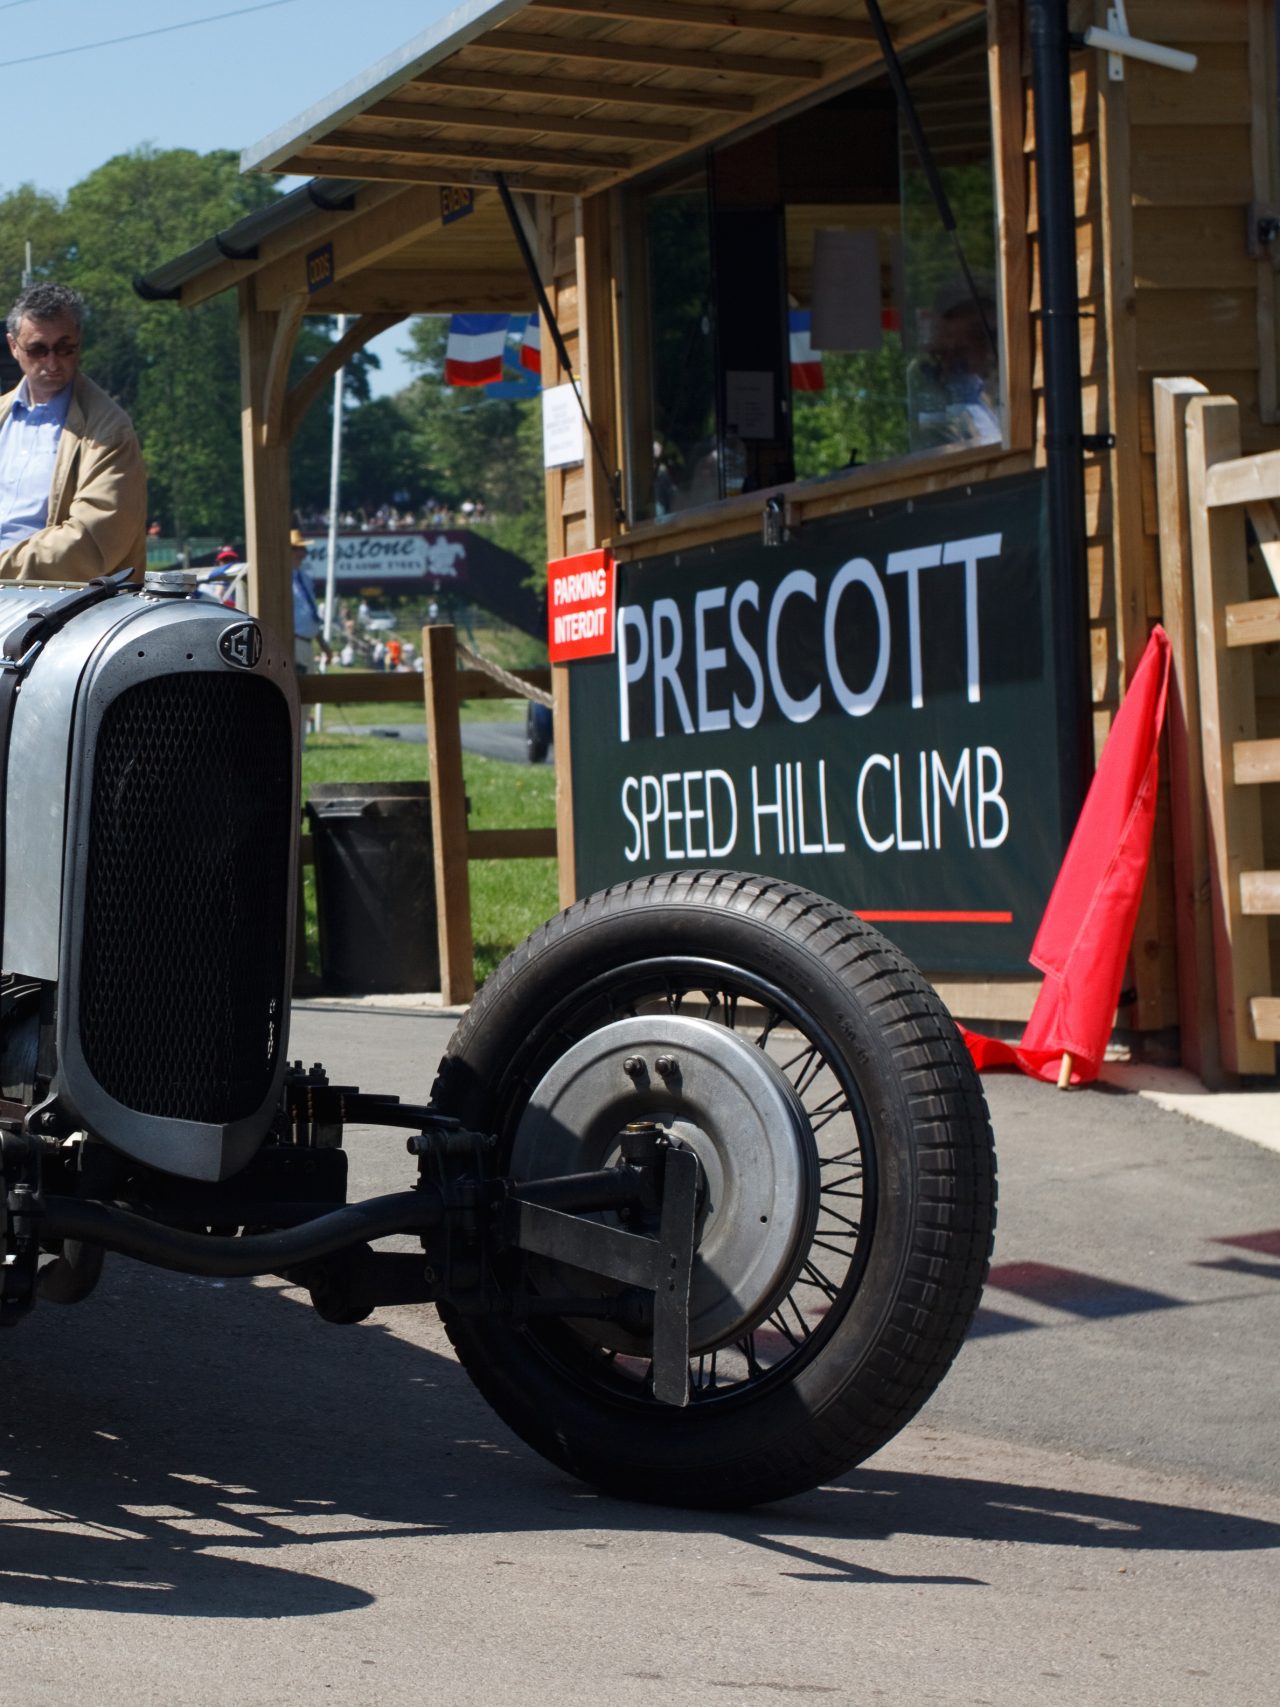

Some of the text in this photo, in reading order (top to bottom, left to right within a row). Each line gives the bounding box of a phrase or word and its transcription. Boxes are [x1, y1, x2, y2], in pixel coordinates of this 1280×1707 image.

[554, 568, 606, 606] PARKING
[554, 607, 607, 645] INTERDIT
[617, 532, 1003, 742] PRESCOTT
[621, 745, 1010, 863] SPEED HILL CLIMB
